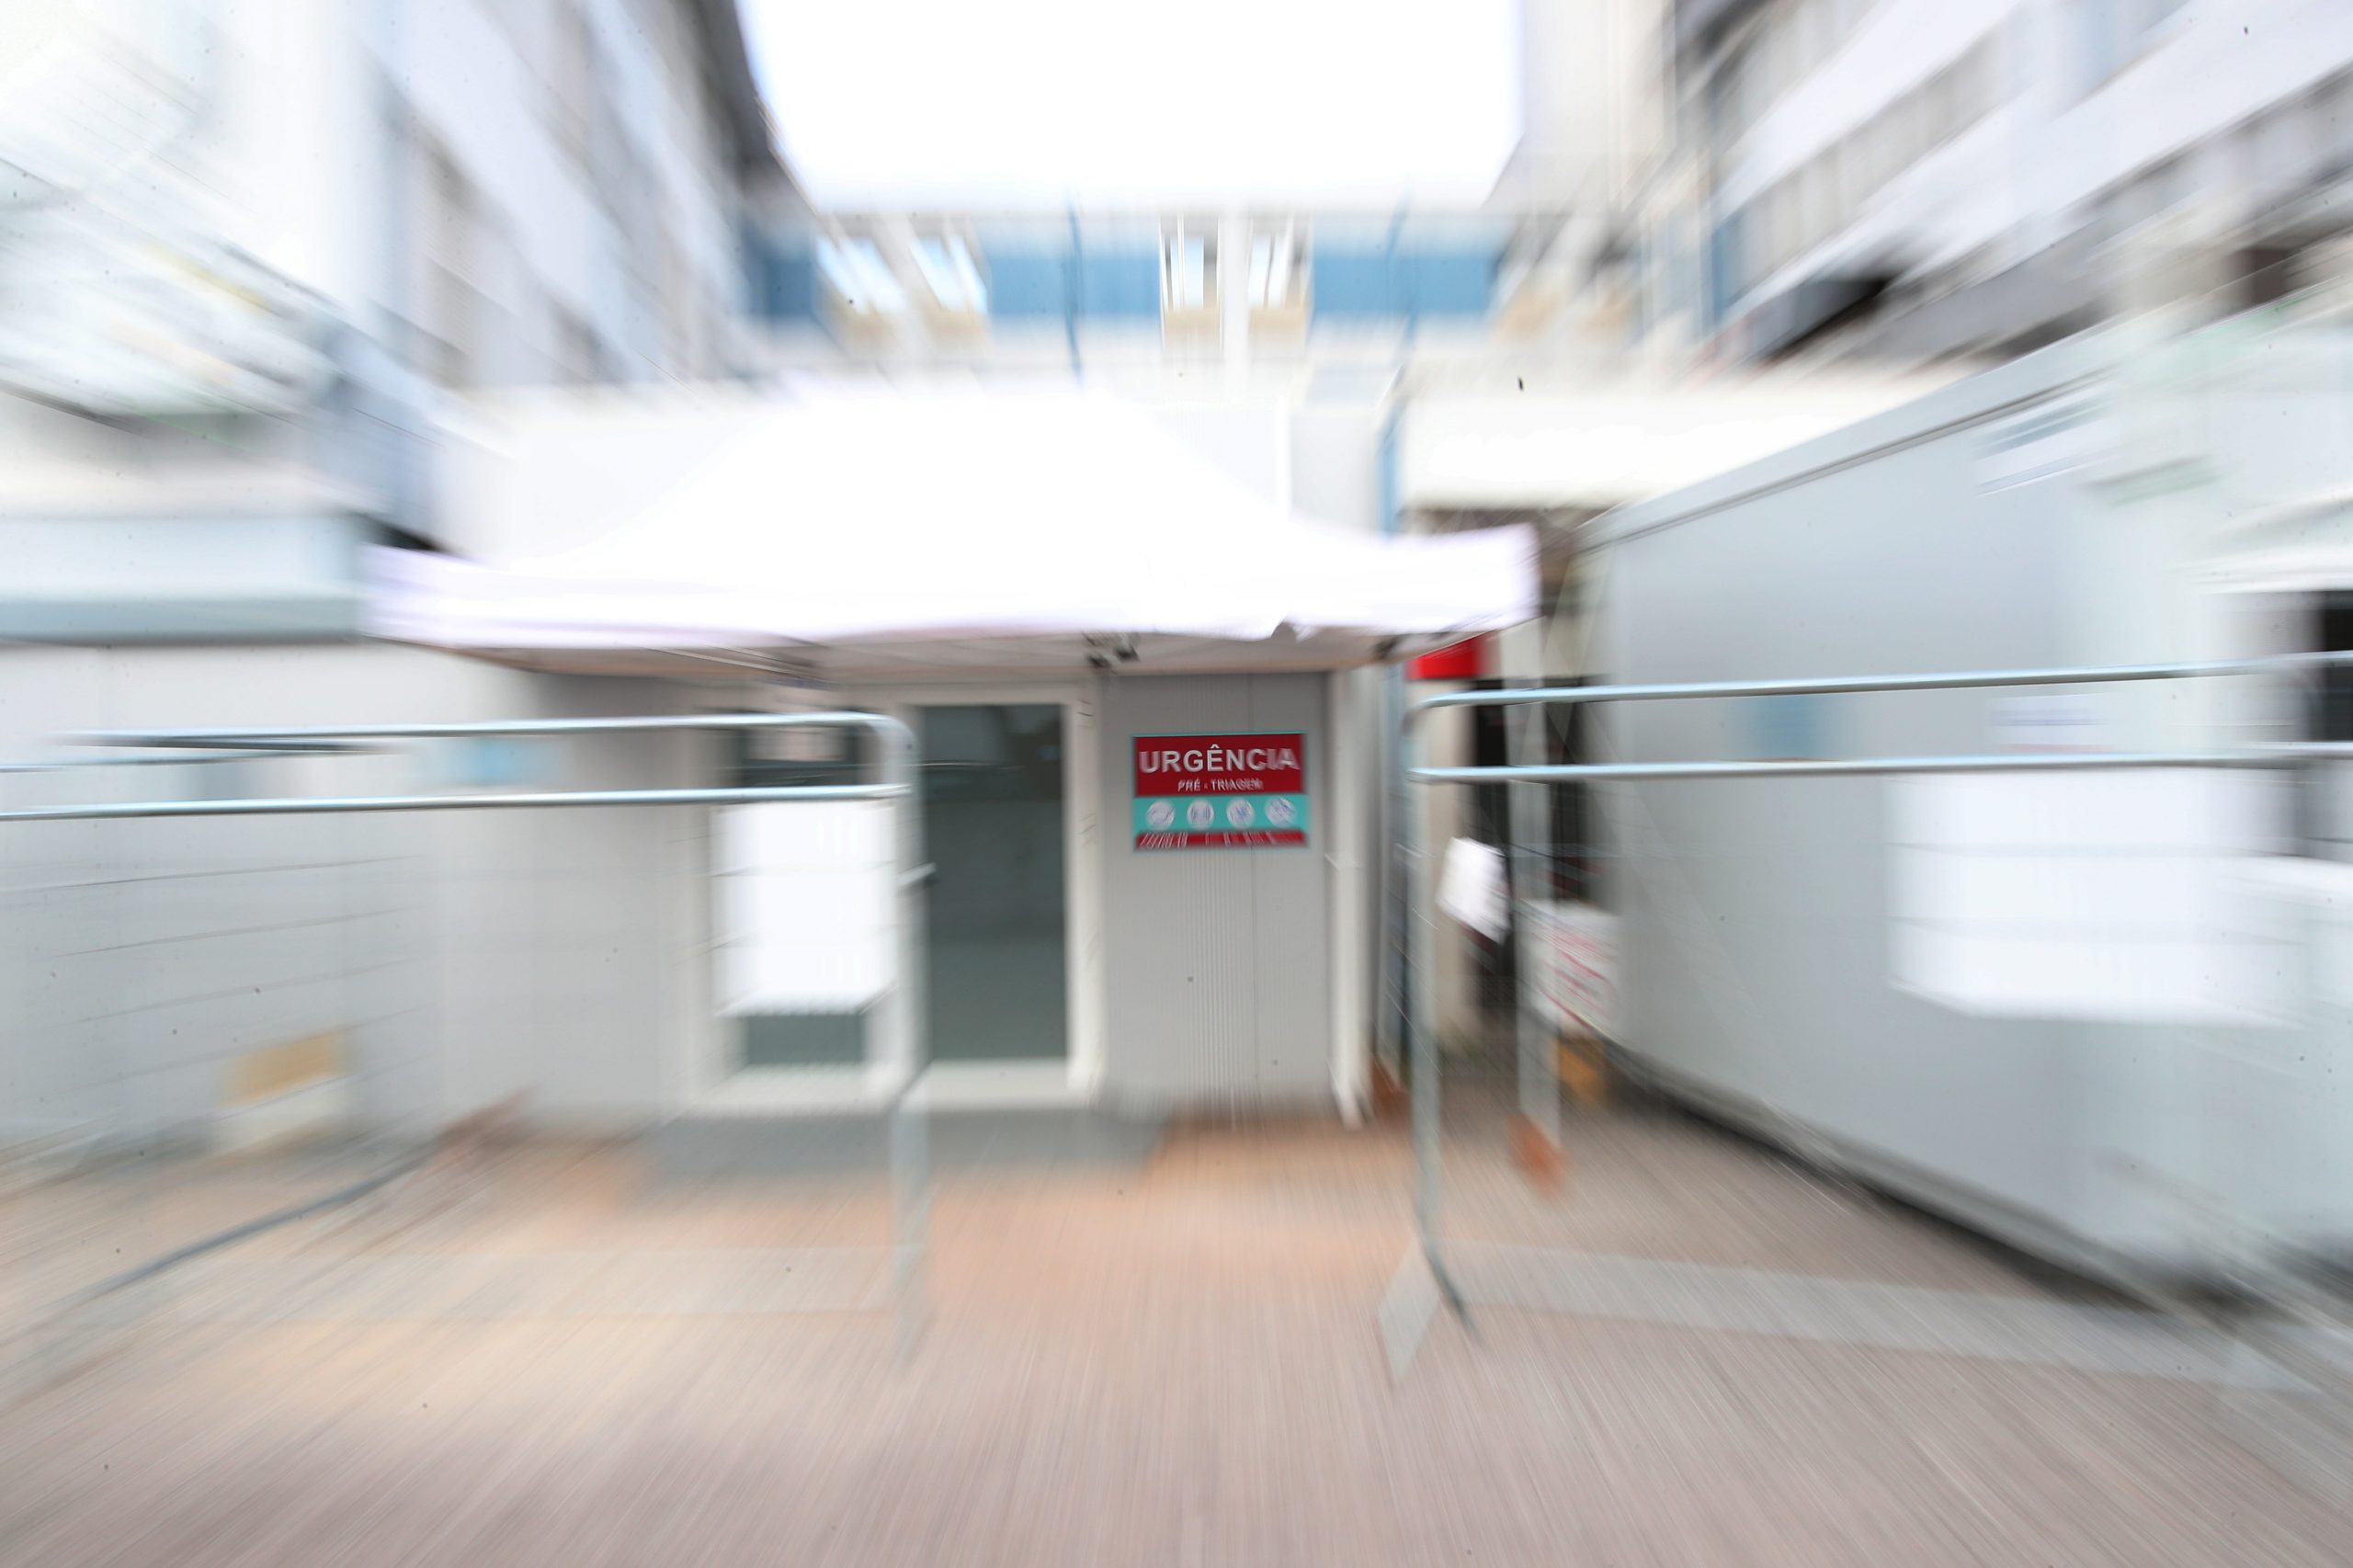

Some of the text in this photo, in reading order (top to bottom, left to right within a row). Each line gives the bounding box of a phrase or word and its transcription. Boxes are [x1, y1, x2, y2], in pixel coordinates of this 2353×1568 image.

[1139, 744, 1301, 774] URGÊNCIA
[1177, 778, 1201, 791] PRÉ
[1211, 778, 1264, 790] TRIAGEM
